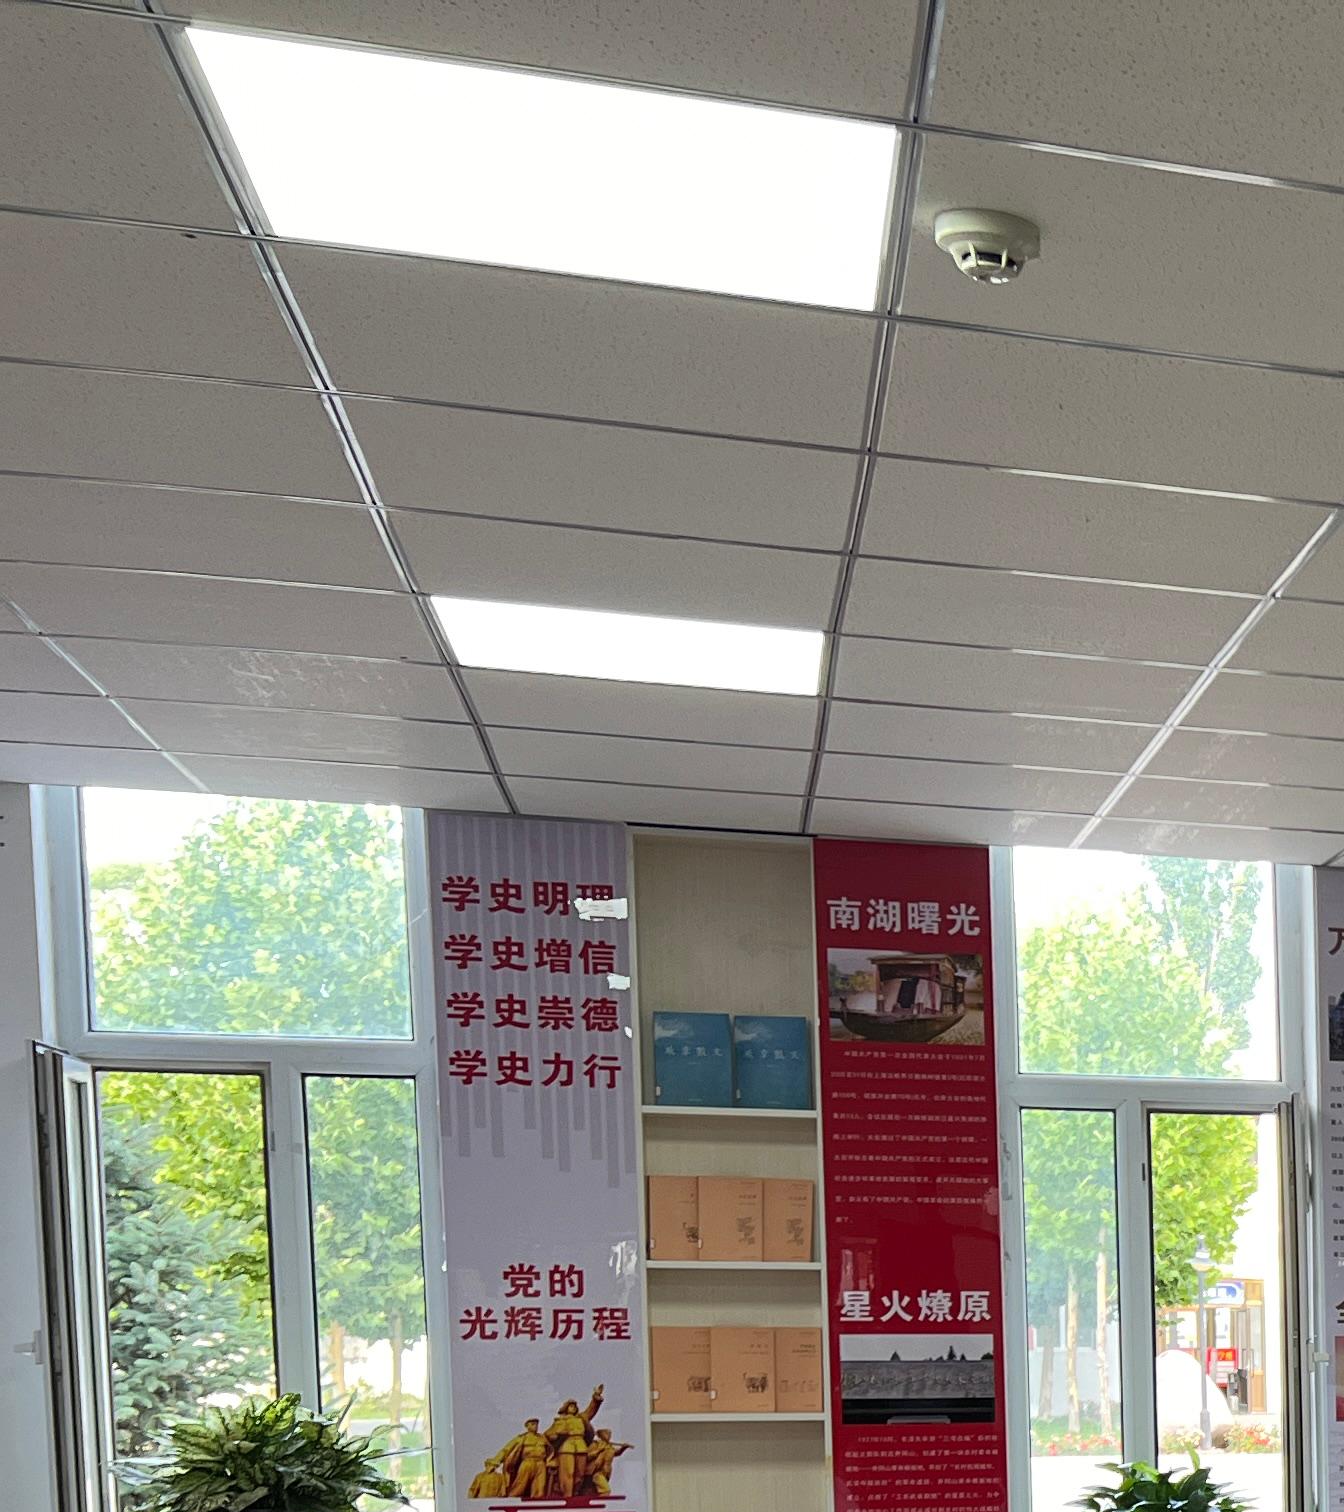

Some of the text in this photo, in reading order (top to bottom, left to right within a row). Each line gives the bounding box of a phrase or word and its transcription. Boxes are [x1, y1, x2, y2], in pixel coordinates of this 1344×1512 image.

[827, 897, 980, 936] 南湖曙光
[444, 934, 617, 975] 学史增信
[447, 992, 619, 1032] 学史崇德
[449, 1050, 621, 1089] 学史力行
[502, 1264, 584, 1299] 党的
[459, 1306, 632, 1342] 光辉历程
[839, 1290, 992, 1323] 星火燎原
